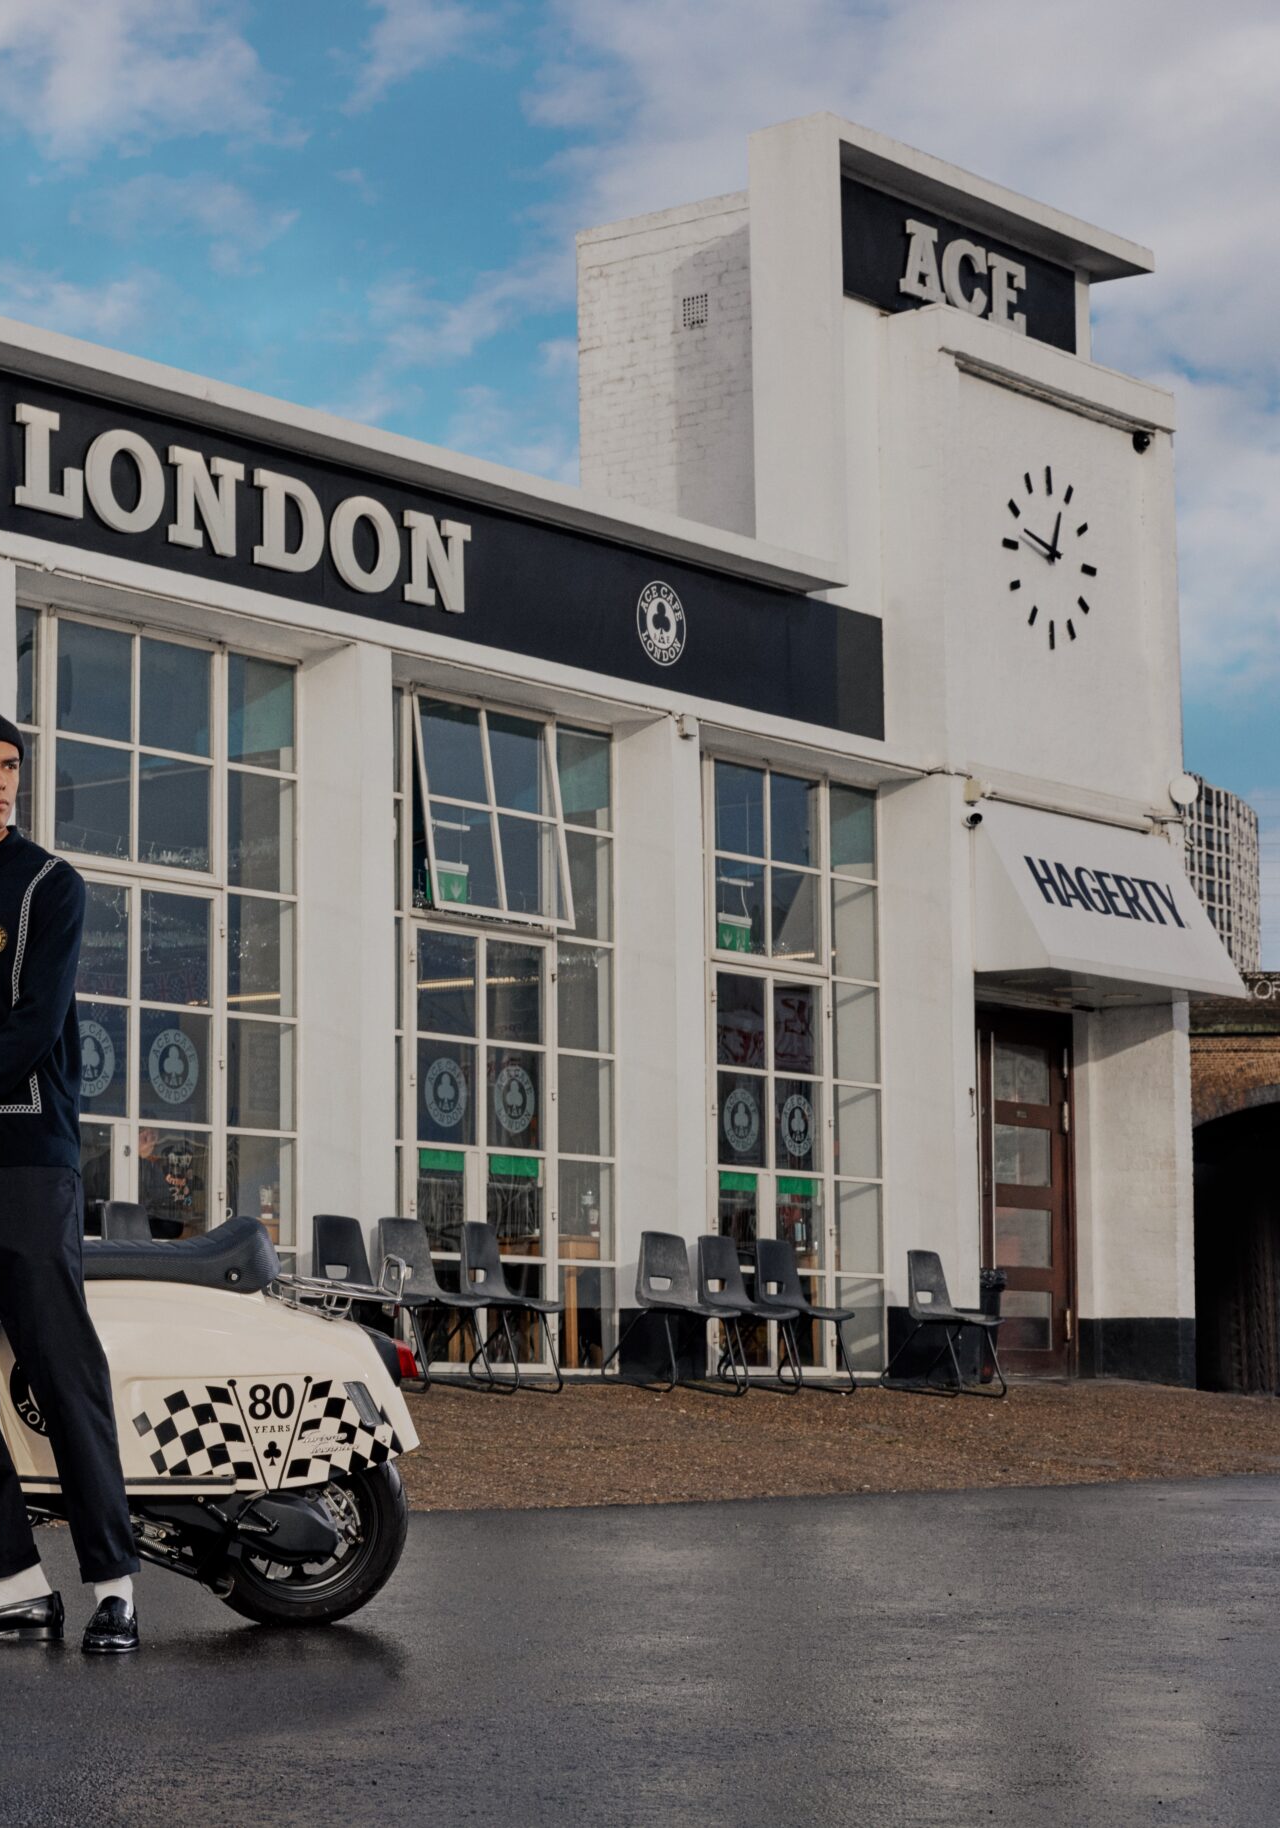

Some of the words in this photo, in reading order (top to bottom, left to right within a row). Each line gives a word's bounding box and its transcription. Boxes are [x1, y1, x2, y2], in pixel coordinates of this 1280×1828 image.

[899, 218, 1027, 336] ACE
[14, 402, 472, 614] LONDON
[640, 586, 658, 613] ACE
[660, 586, 682, 622] CAFE
[642, 630, 681, 662] LONDON
[1023, 855, 1186, 929] HAGERTY
[88, 1023, 112, 1054] CAFE
[152, 1033, 170, 1059] ACE
[80, 1071, 109, 1094] NDON
[153, 1075, 194, 1100] LONDON
[248, 1382, 295, 1420] 80
[253, 1424, 291, 1434] YEARS
